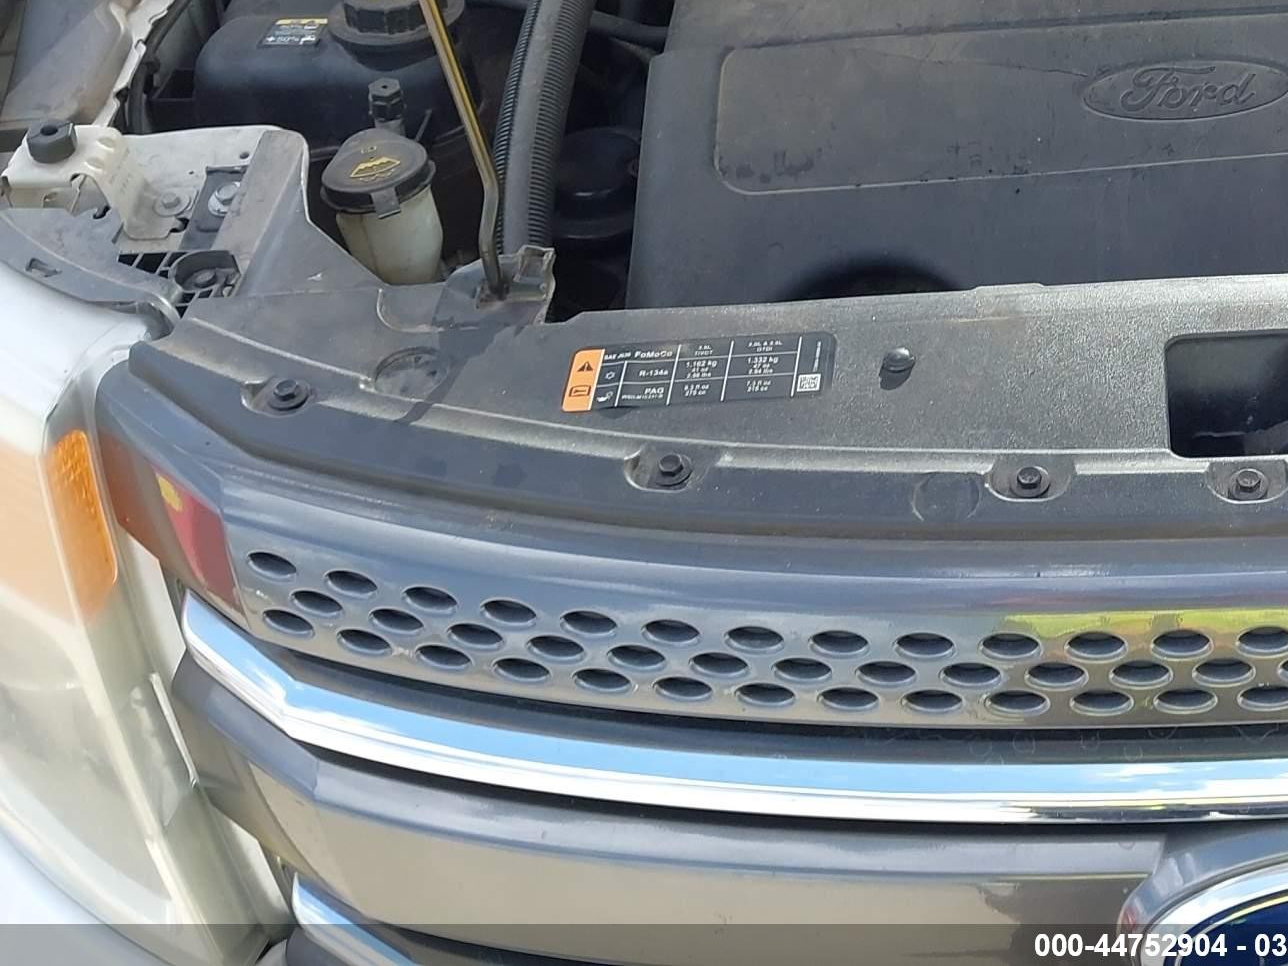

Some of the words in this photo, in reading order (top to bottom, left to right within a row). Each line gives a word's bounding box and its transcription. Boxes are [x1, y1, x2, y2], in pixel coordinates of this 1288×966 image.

[1120, 65, 1256, 113] Ford
[634, 350, 673, 359] FoMoCo
[639, 369, 669, 377] R-134a
[644, 387, 665, 395] PAG
